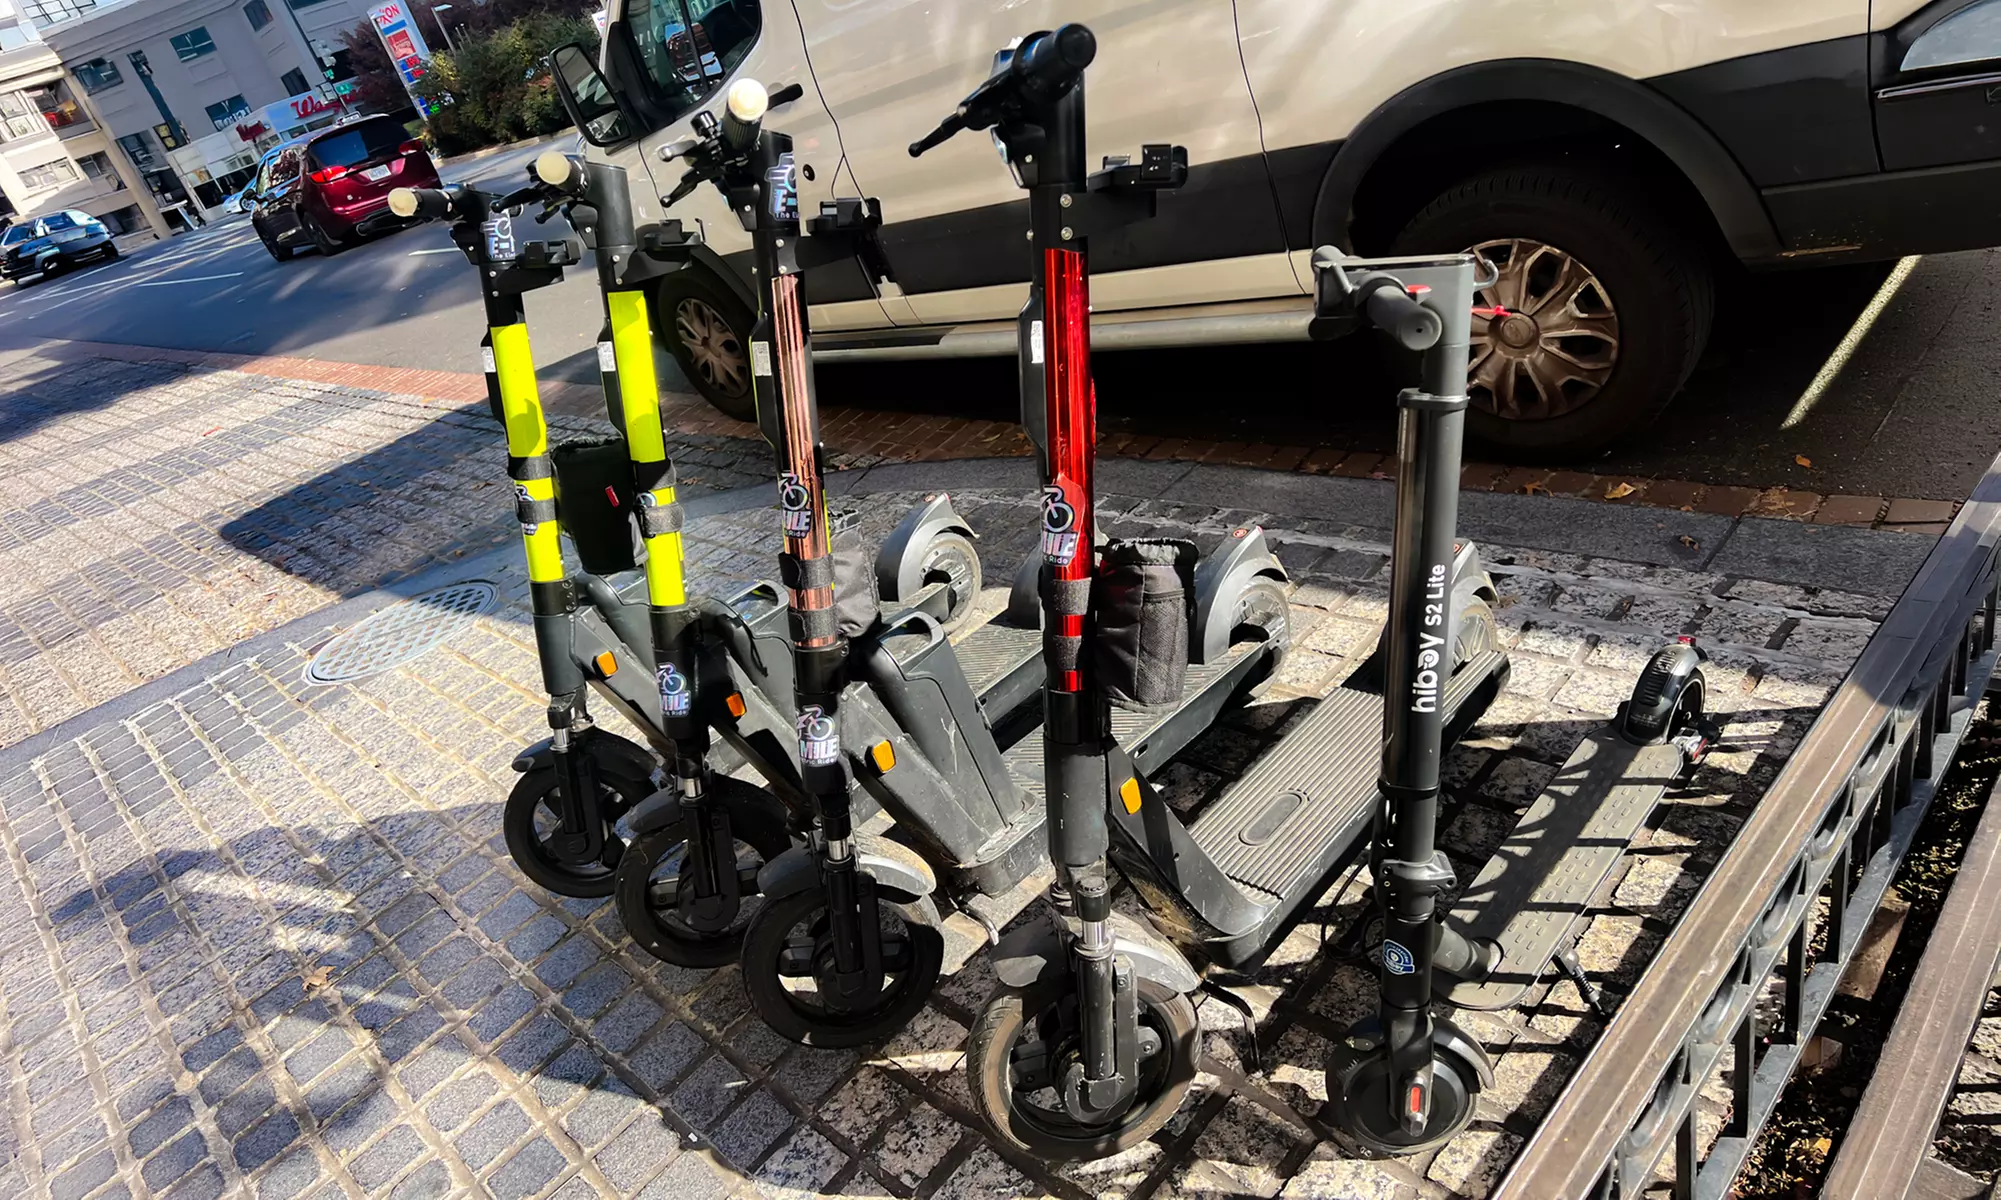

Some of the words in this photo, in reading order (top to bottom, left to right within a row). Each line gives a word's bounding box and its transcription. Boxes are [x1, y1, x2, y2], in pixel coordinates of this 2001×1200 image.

[1426, 564, 1446, 599] Lite
[1424, 602, 1443, 626] S2
[1411, 632, 1445, 713] hiboy
